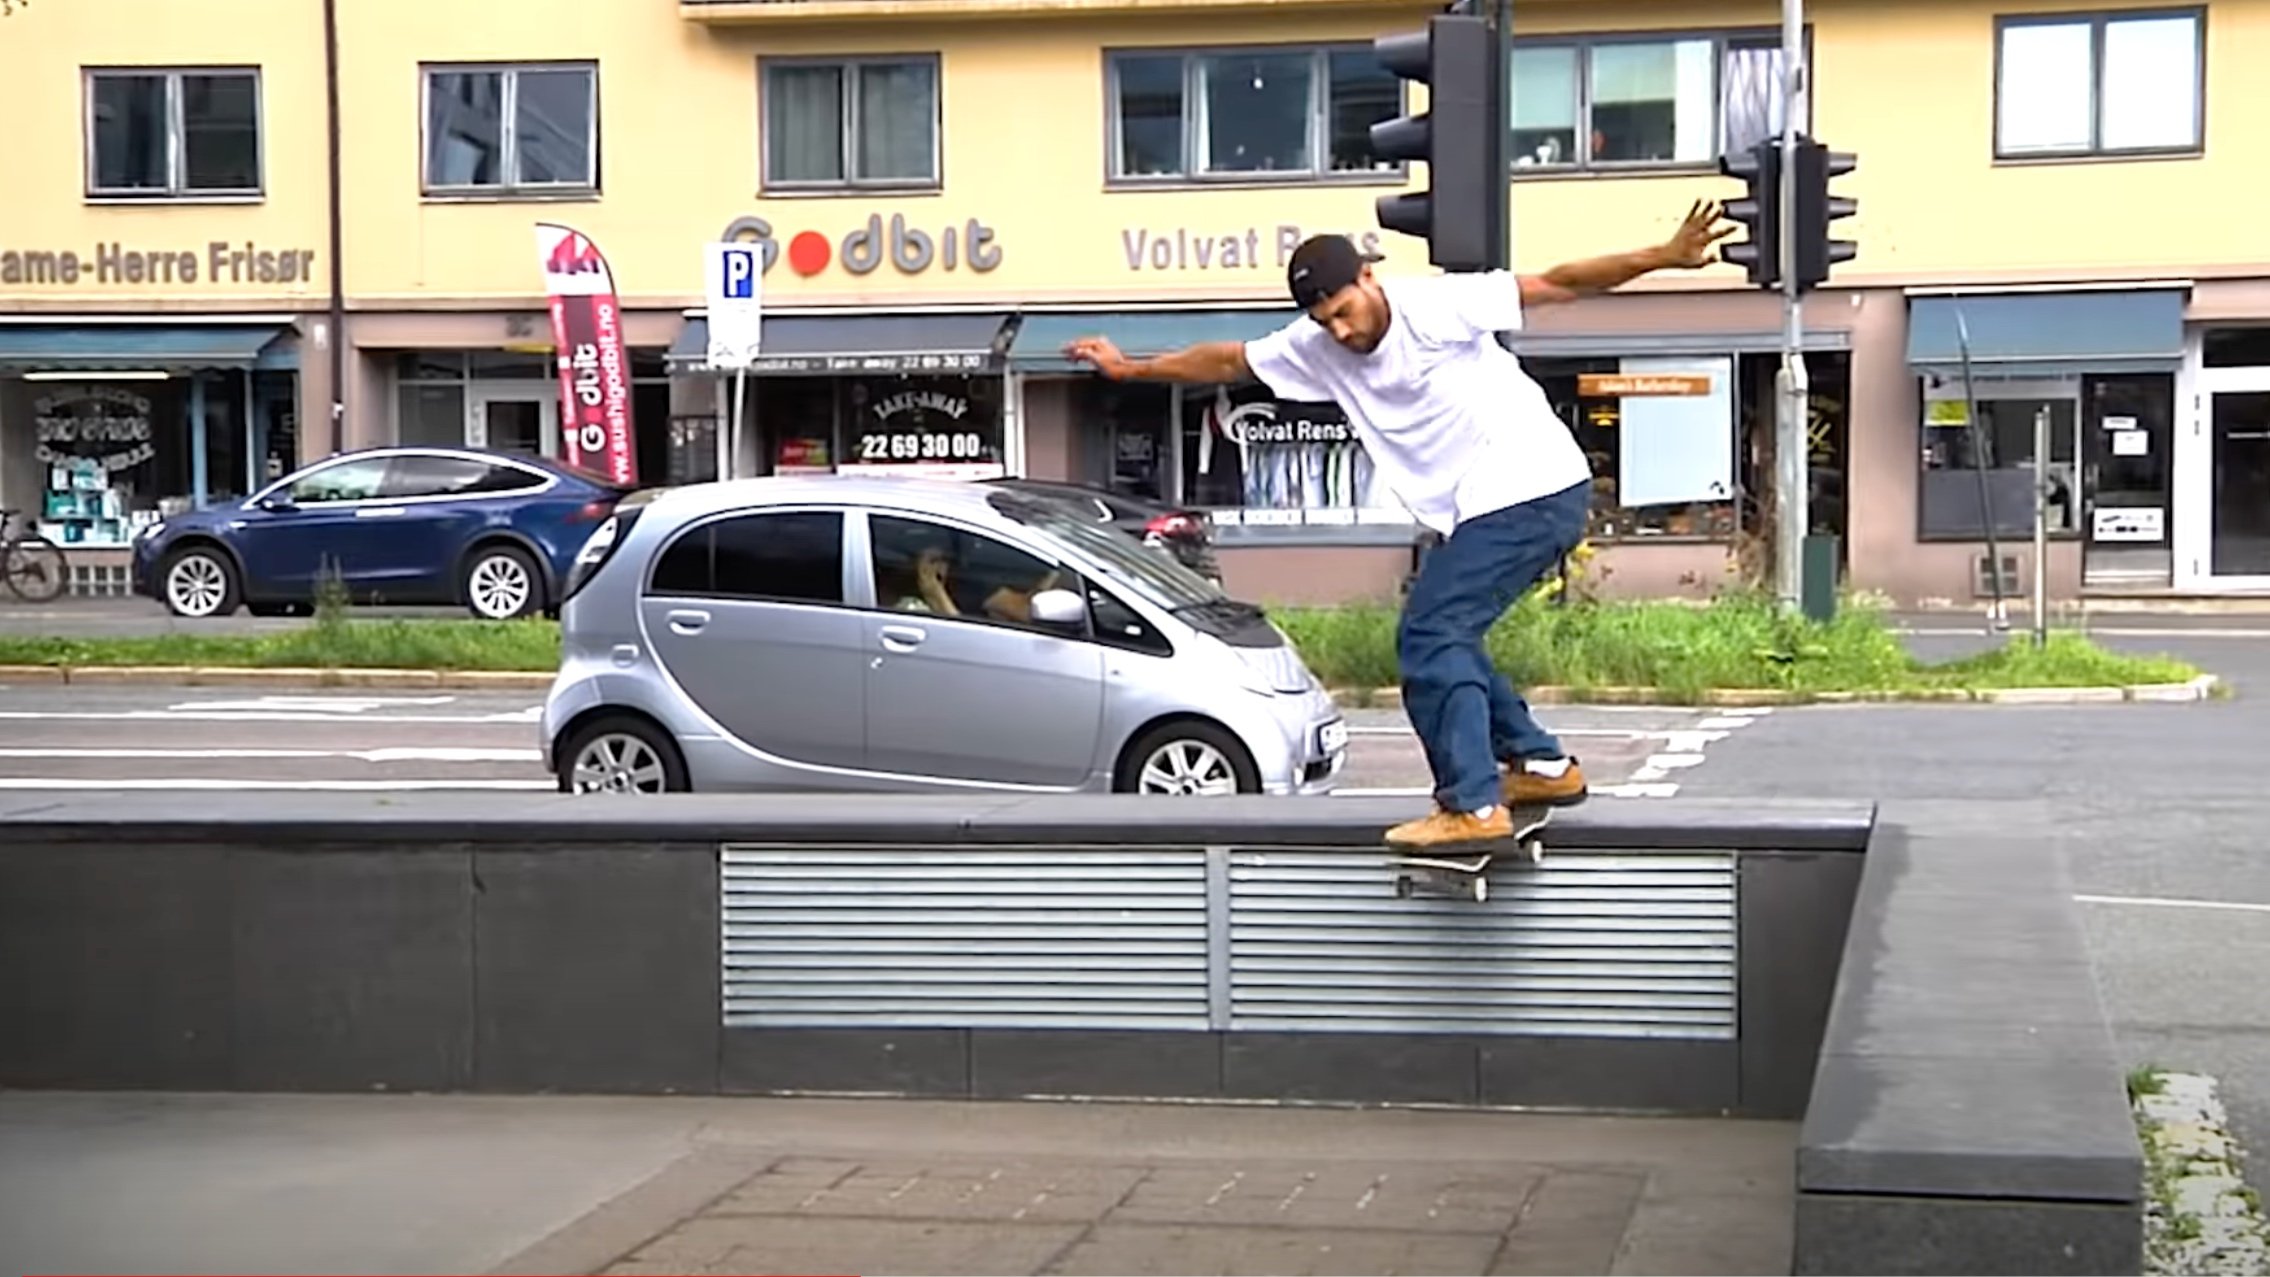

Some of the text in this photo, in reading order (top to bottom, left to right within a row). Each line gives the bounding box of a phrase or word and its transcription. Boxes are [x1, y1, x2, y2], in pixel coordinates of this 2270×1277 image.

[208, 241, 314, 284] Frisør
[1122, 225, 1380, 271] Volvat Rs
[727, 253, 750, 297] P
[902, 356, 919, 368] 22
[942, 355, 960, 367] 30
[962, 354, 980, 367] 00
[861, 433, 980, 459] 22 69 30 00
[1235, 419, 1294, 442] Volvat
[1297, 419, 1348, 441] Rens
